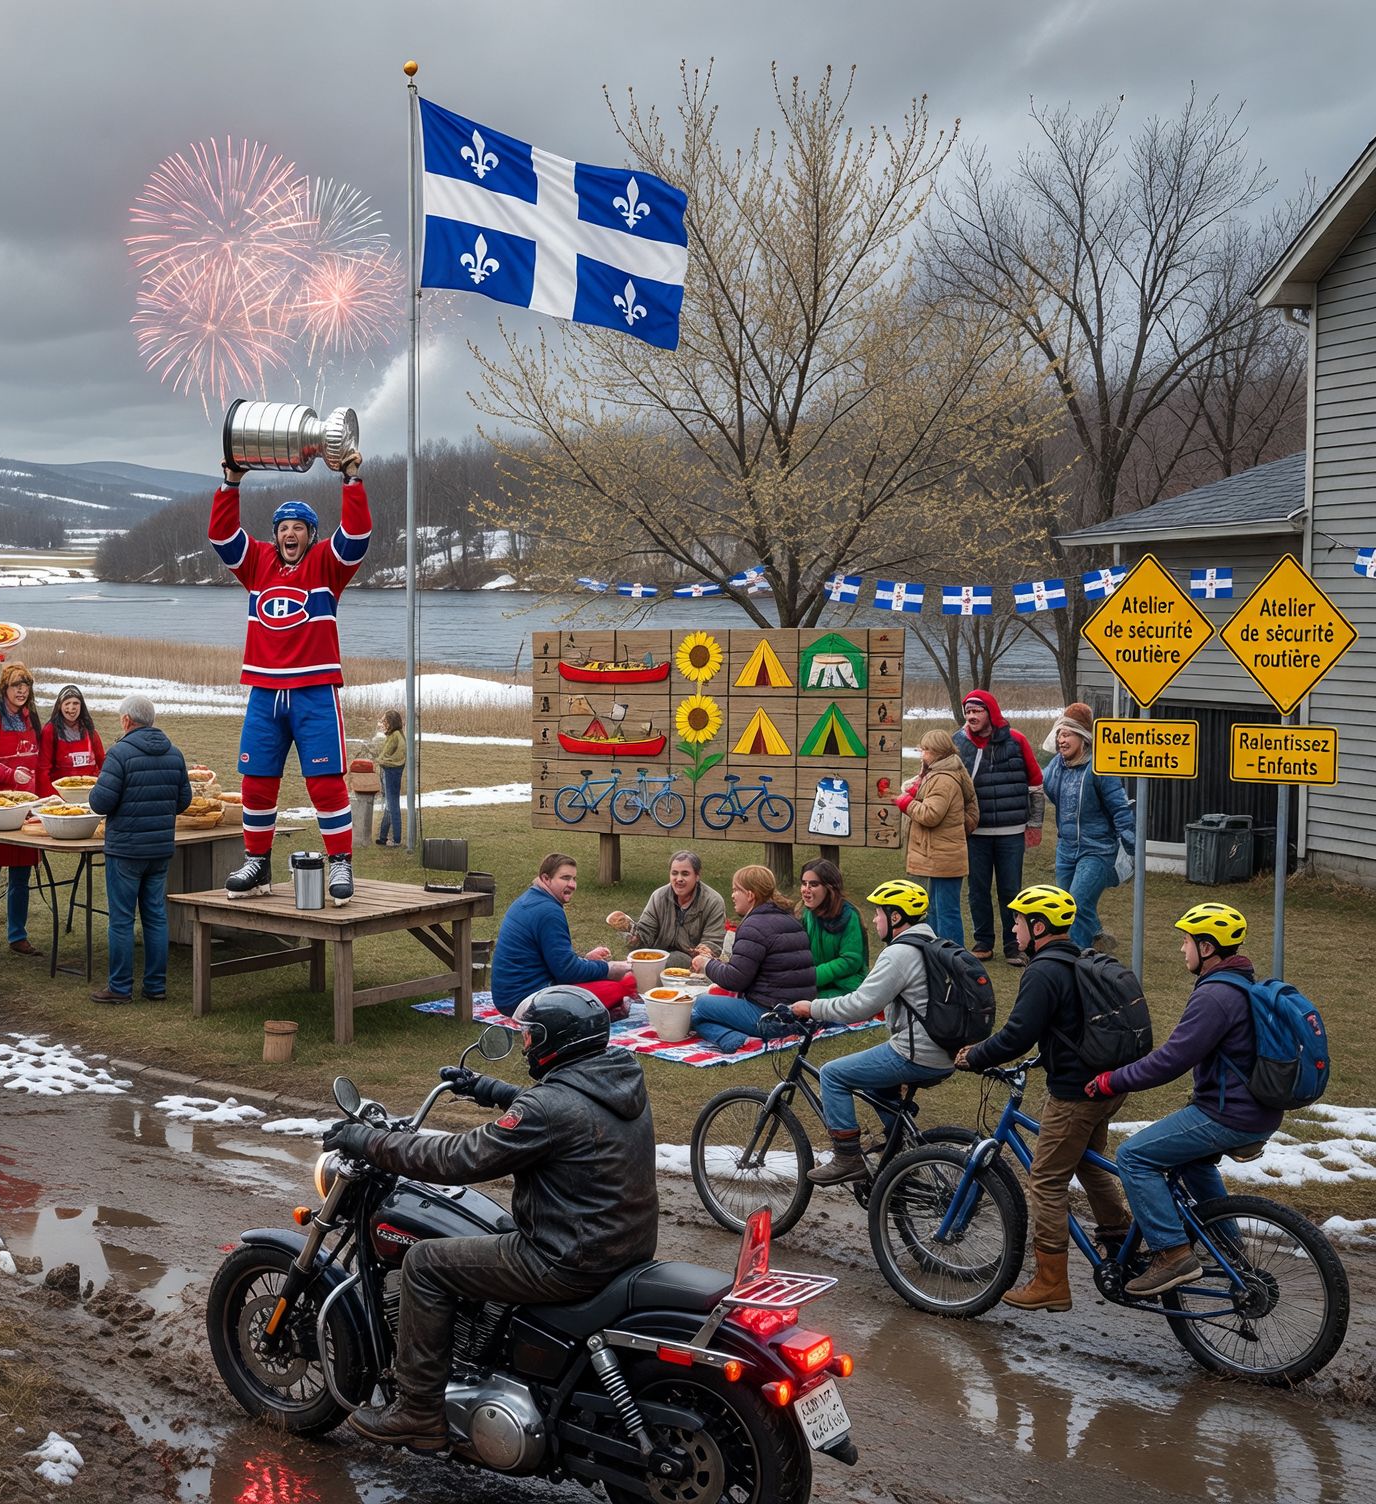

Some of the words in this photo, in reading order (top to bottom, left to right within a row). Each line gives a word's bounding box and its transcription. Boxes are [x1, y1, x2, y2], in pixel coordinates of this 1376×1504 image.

[1122, 596, 1174, 613] Atelier
[1260, 598, 1315, 616] Atelier
[1104, 620, 1123, 638] de
[1129, 620, 1192, 638] sécurité
[1241, 624, 1258, 641] de
[1267, 622, 1333, 642] sécurité
[1116, 645, 1180, 663] routière
[1255, 649, 1320, 668] routière
[1103, 727, 1190, 745] Ralentissez
[1240, 733, 1329, 752] Ralentissez
